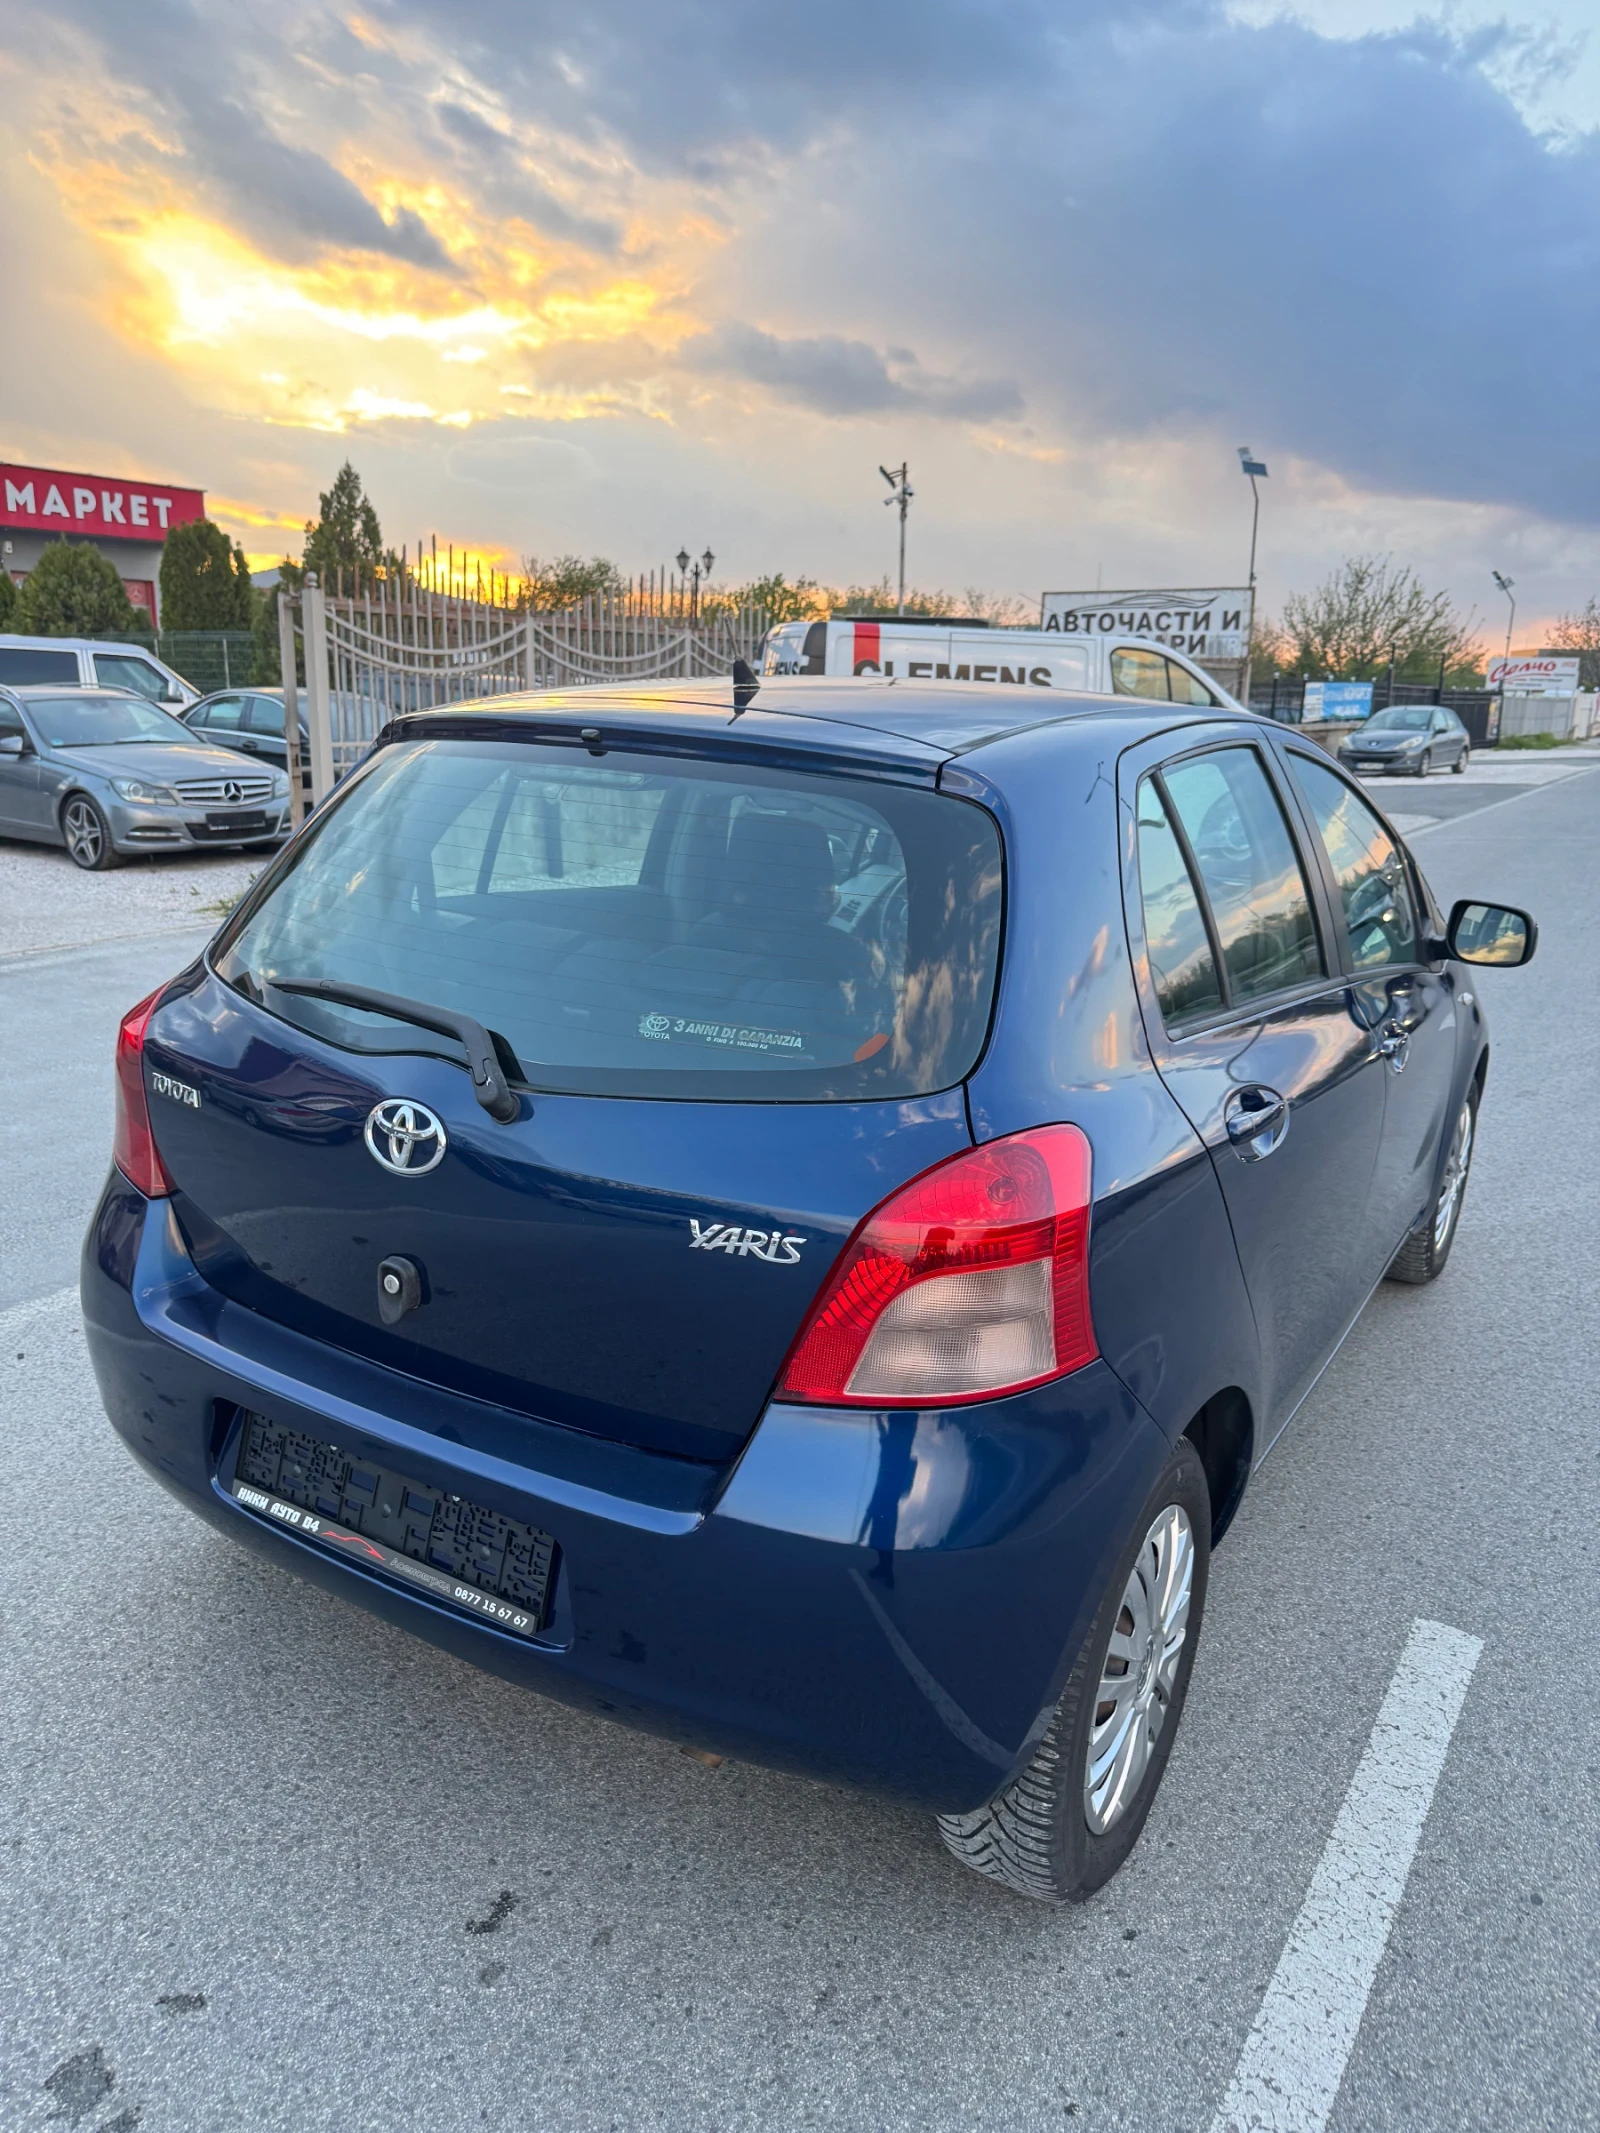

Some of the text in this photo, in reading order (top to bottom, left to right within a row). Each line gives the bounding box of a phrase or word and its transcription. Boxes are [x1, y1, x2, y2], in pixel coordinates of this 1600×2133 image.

[5, 479, 172, 529] МАРКЕТ
[1045, 610, 1241, 634] АВТОЧАСТИ И
[639, 1029, 670, 1040] OYOTA
[674, 1019, 686, 1033] 3
[685, 1023, 719, 1036] ANNI
[721, 1027, 736, 1039] DI
[152, 1072, 202, 1108] TOYOTA
[454, 1586, 528, 1628] 0877 15 67 67
